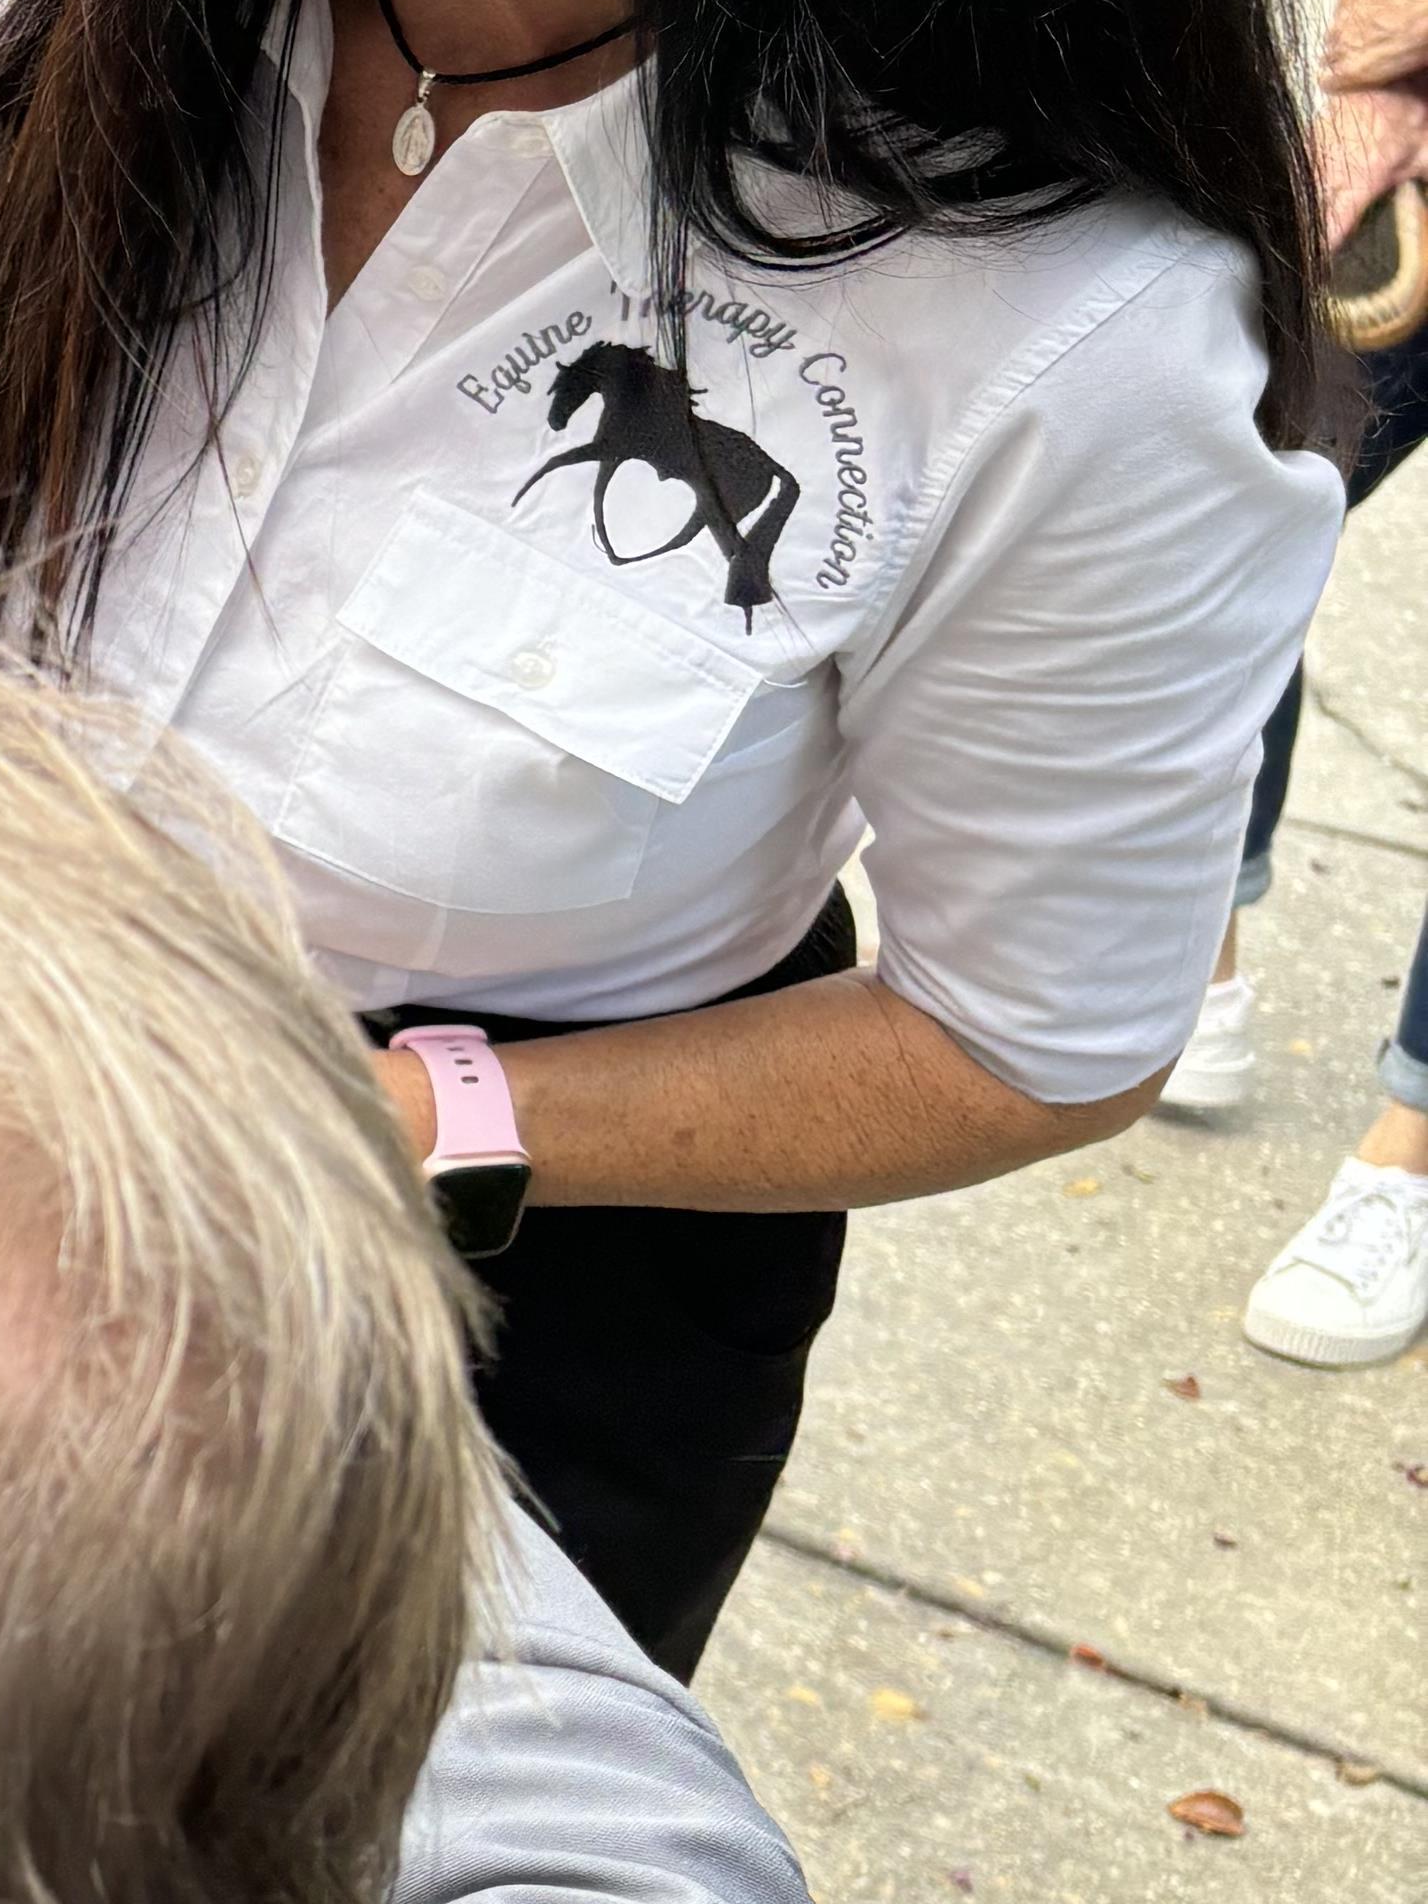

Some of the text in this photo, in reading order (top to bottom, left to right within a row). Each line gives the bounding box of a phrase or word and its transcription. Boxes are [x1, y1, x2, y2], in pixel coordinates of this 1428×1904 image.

[456, 280, 874, 589] Equine erapy Connection
